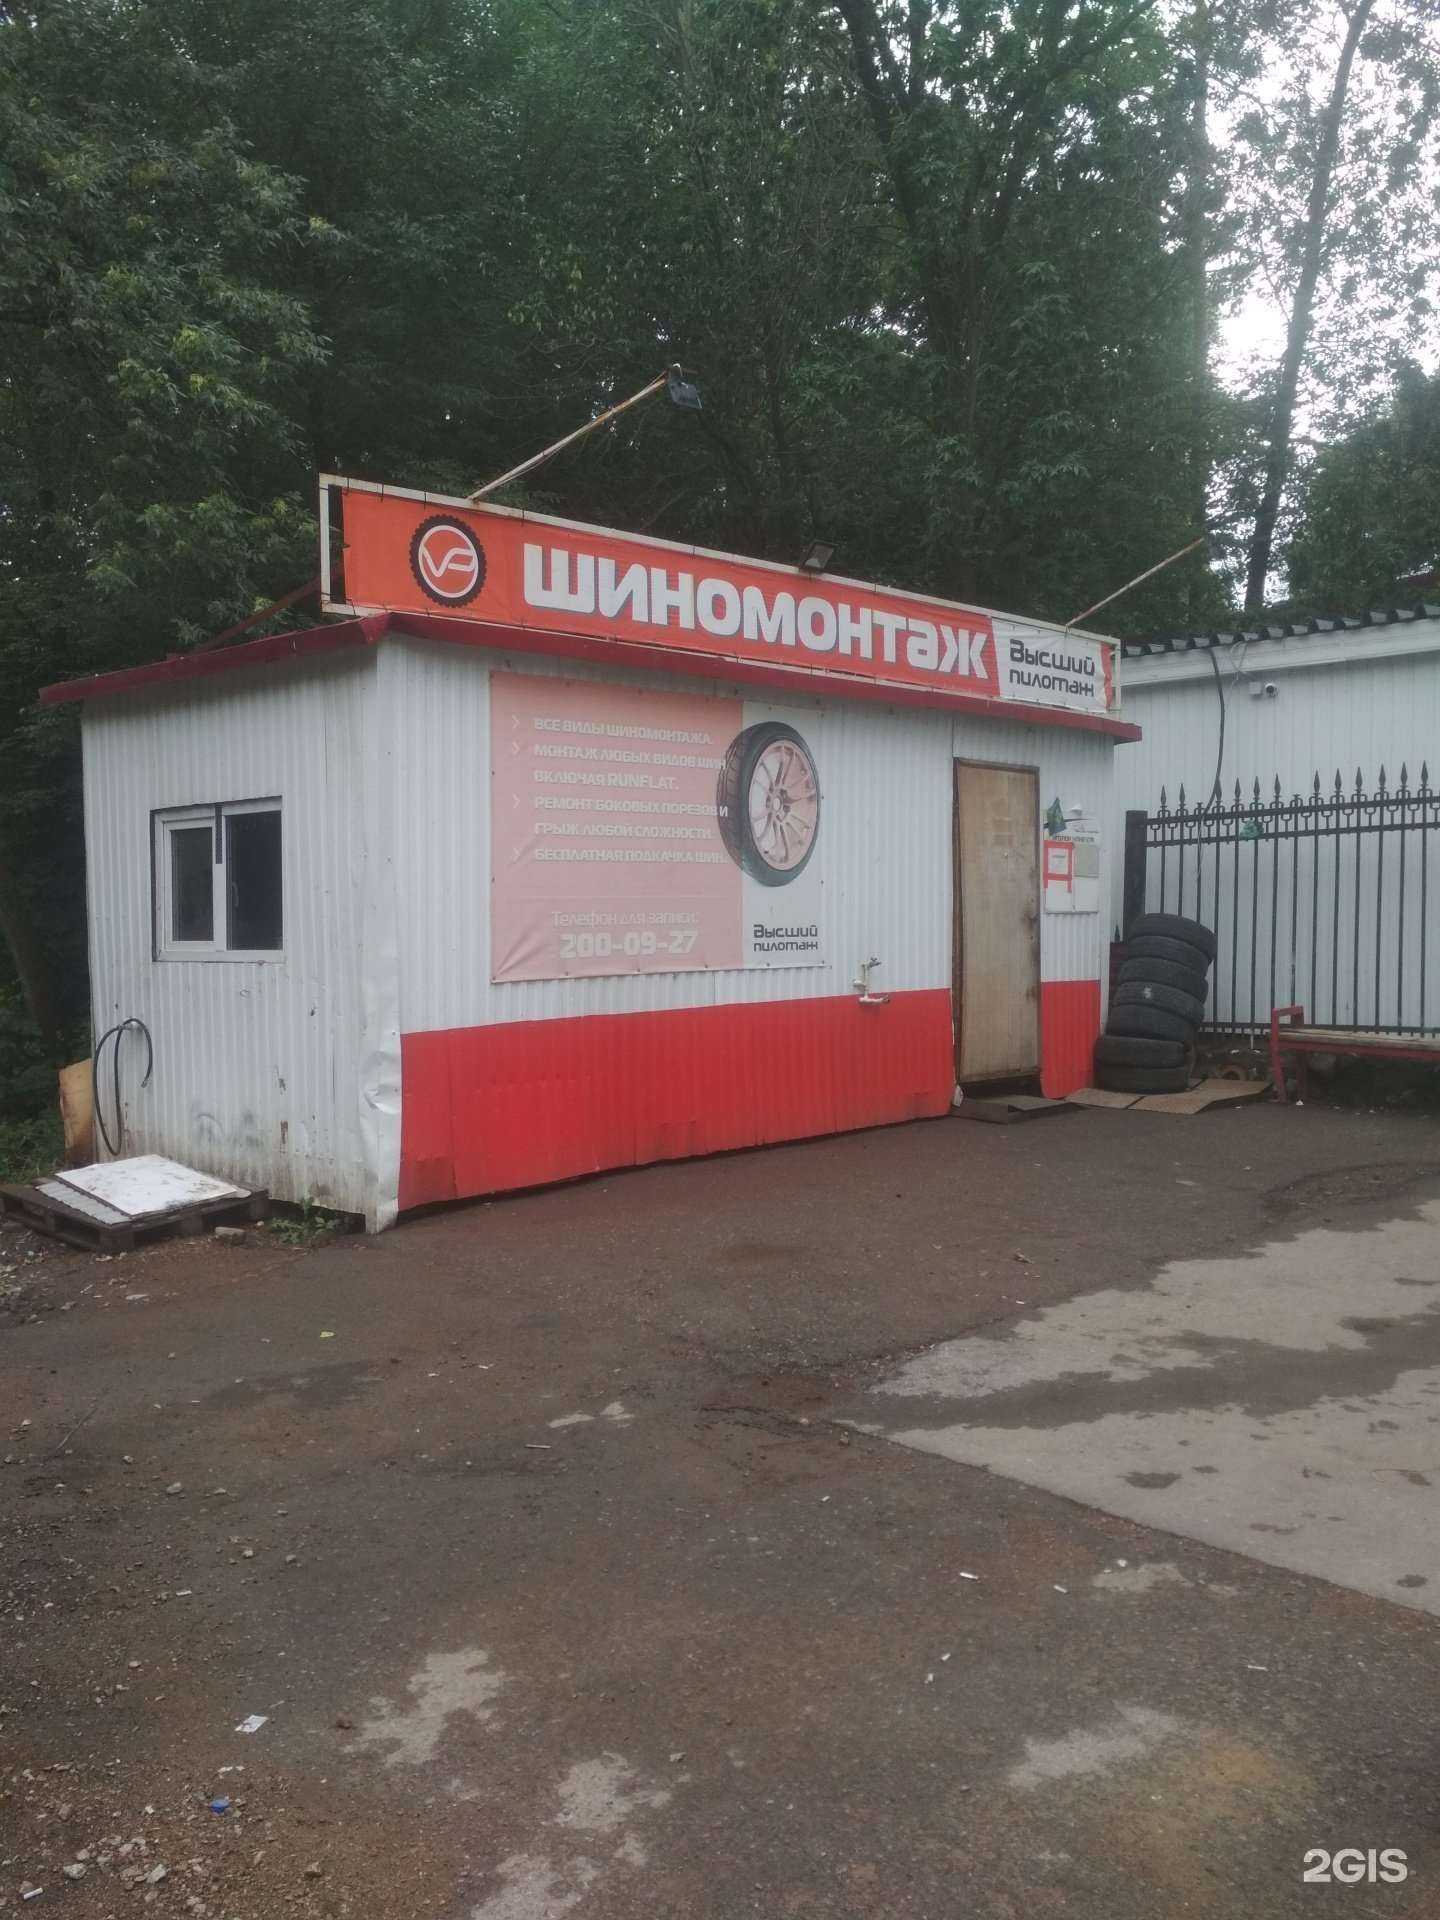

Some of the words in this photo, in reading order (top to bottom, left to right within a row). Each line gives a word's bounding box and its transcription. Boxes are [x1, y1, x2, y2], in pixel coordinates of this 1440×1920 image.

[1009, 638, 1095, 676] Высший
[534, 717, 561, 732] ВСЕ
[562, 719, 604, 736] ВИДЫ
[534, 744, 599, 761] МОНТАЖ
[601, 748, 650, 764] ЛЮБЫХ
[653, 752, 696, 767] ВИДОВ
[534, 769, 606, 786] ВКЛЮЧАЯ
[534, 796, 593, 812] РЕМОНТ
[595, 799, 661, 814] БОКОВЫХ
[662, 802, 718, 817] ПОРЕЗОВ
[719, 805, 729, 818] И
[534, 822, 580, 837] ГРЫЖ
[583, 823, 633, 838] ЛЮБОЙ
[535, 848, 624, 863] БЕСПЛАТНАЯ
[625, 849, 694, 863] ПОДКАЧКА
[552, 911, 616, 929] Телефон
[618, 912, 645, 928] для
[753, 924, 818, 939] Высший
[559, 930, 699, 959] 200-09-27
